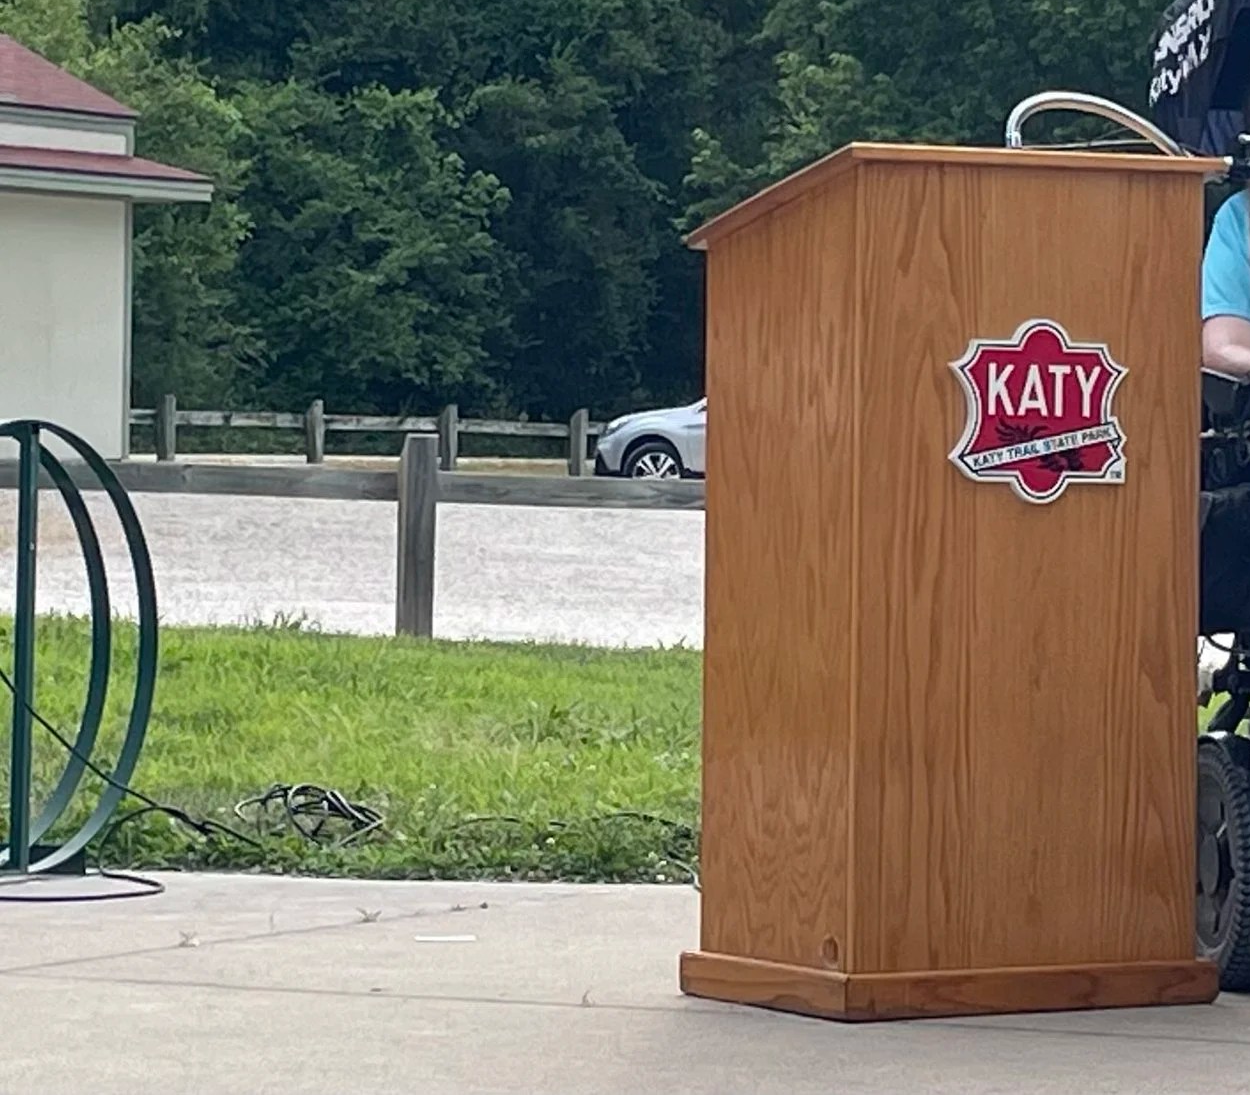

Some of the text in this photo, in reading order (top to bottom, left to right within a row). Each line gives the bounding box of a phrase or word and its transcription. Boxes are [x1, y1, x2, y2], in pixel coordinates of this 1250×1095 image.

[987, 362, 1101, 418] KATY
[972, 427, 1113, 468] KATY TRAIL STATE PARK
